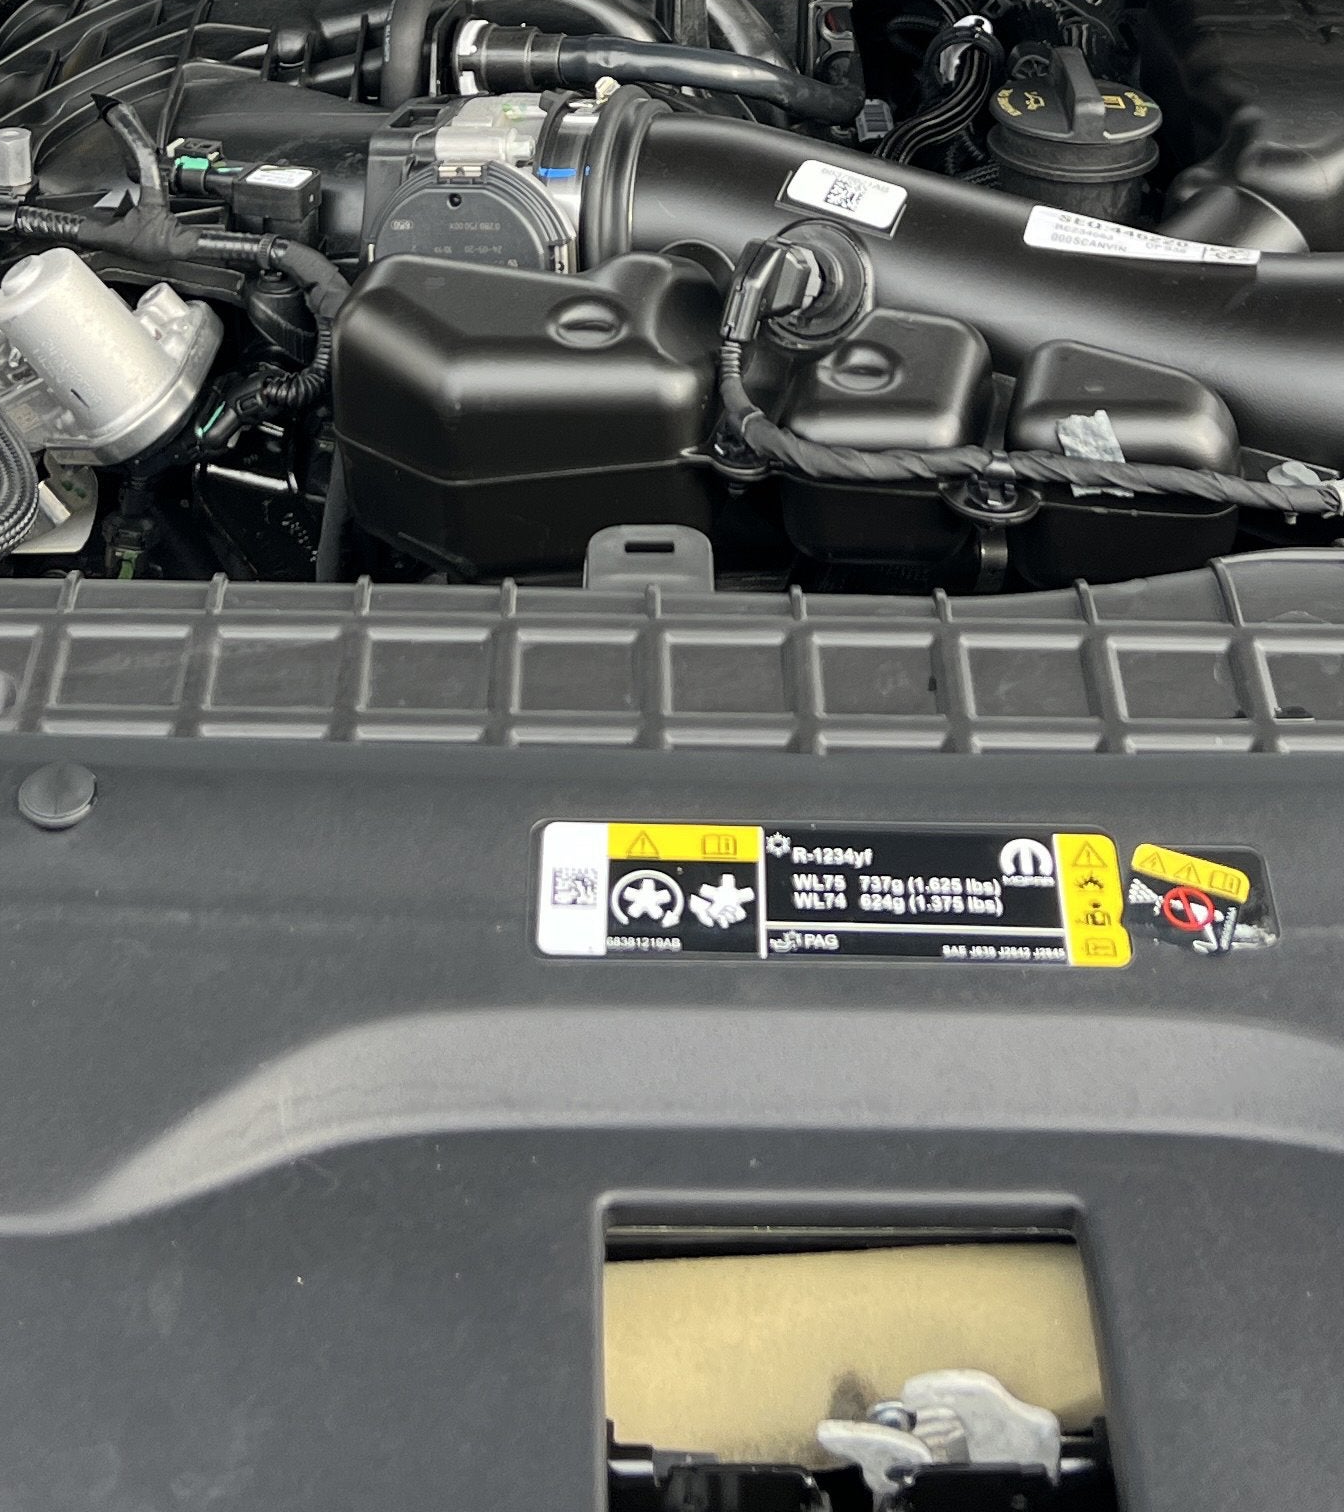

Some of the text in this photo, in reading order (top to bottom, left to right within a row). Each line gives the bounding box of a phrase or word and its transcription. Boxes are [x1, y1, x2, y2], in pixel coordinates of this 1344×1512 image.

[791, 846, 874, 869] R-1234yf
[792, 872, 1001, 898] WL75 737g (1.625 lbs)
[793, 891, 1004, 918] WL74 624g (1.375 lbs)
[804, 933, 840, 950] PAG
